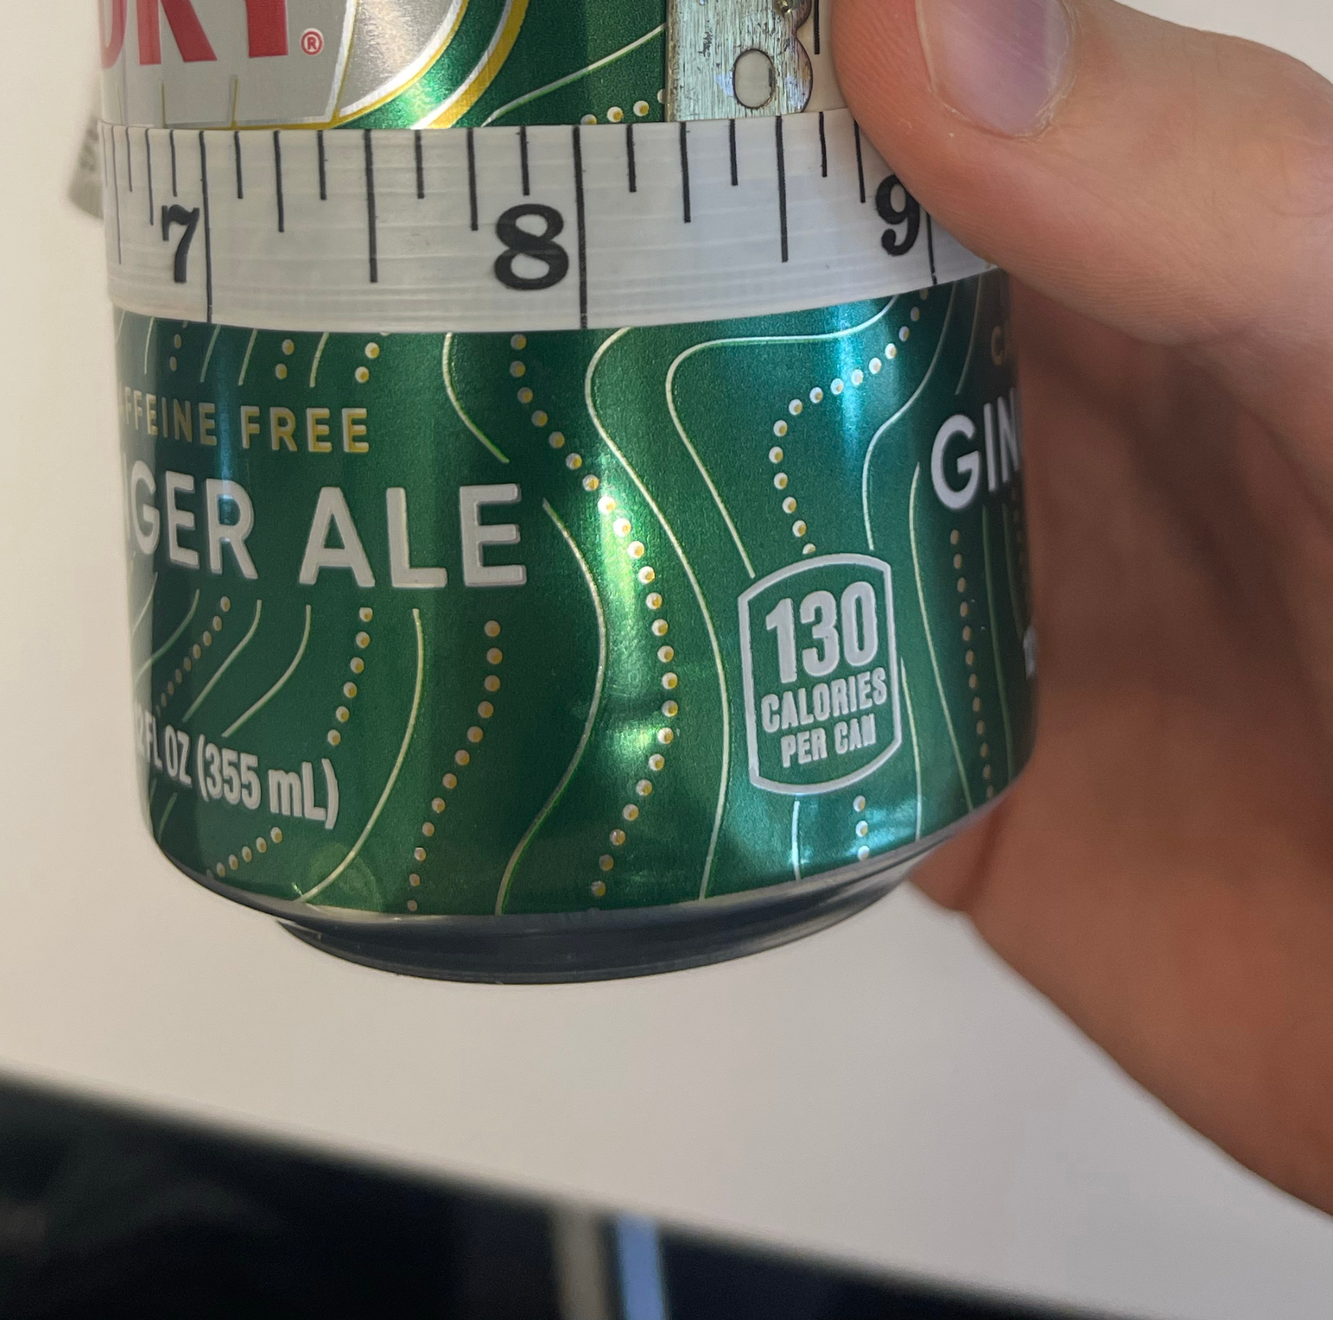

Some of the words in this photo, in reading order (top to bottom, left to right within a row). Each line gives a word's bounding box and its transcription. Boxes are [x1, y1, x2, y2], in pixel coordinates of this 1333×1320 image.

[161, 204, 201, 284] 7
[493, 203, 570, 291] 8
[874, 174, 921, 257] 9
[240, 405, 370, 453] FREE
[298, 483, 528, 588] ALE
[765, 580, 879, 684] 130
[761, 667, 888, 733] CALORIES
[780, 727, 828, 768] PER
[833, 713, 877, 755] CAN
[164, 724, 193, 788] OZ
[197, 733, 262, 811] (355
[267, 757, 340, 830] mL)
